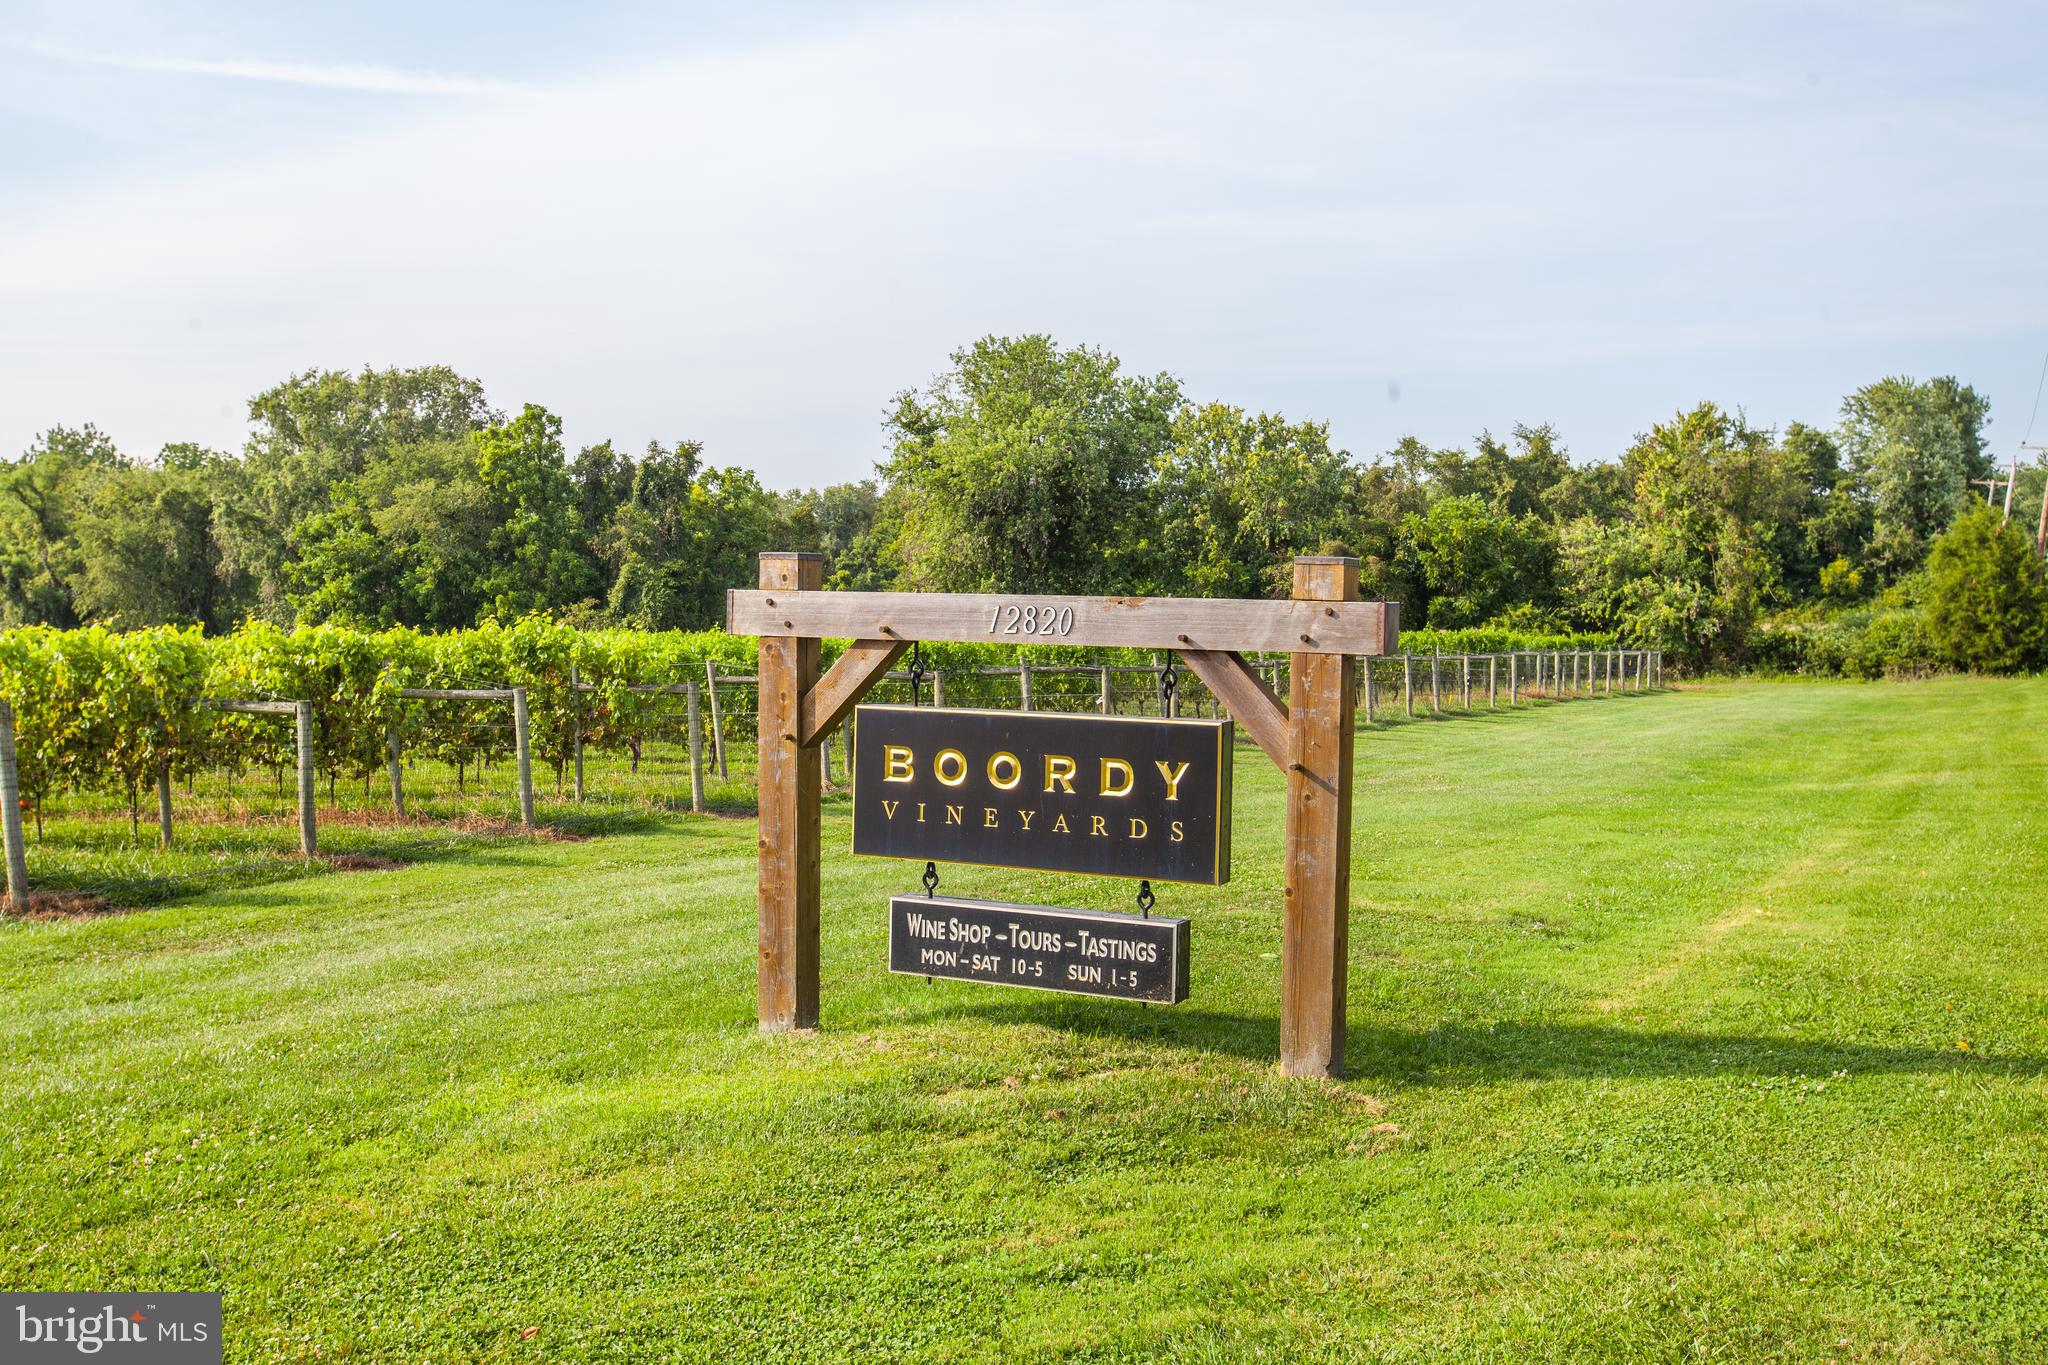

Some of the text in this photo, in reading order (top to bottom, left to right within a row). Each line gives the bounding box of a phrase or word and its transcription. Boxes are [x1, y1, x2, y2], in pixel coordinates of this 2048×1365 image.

[989, 605, 1074, 636] 12820
[883, 745, 1190, 800] BOORDY
[882, 800, 1184, 842] VINEYARDS
[906, 912, 946, 940] WINE
[949, 918, 991, 945] SHOP
[1011, 958, 1043, 977] 10-5
[1068, 964, 1102, 984] SUN
[1112, 969, 1138, 987] 1-5
